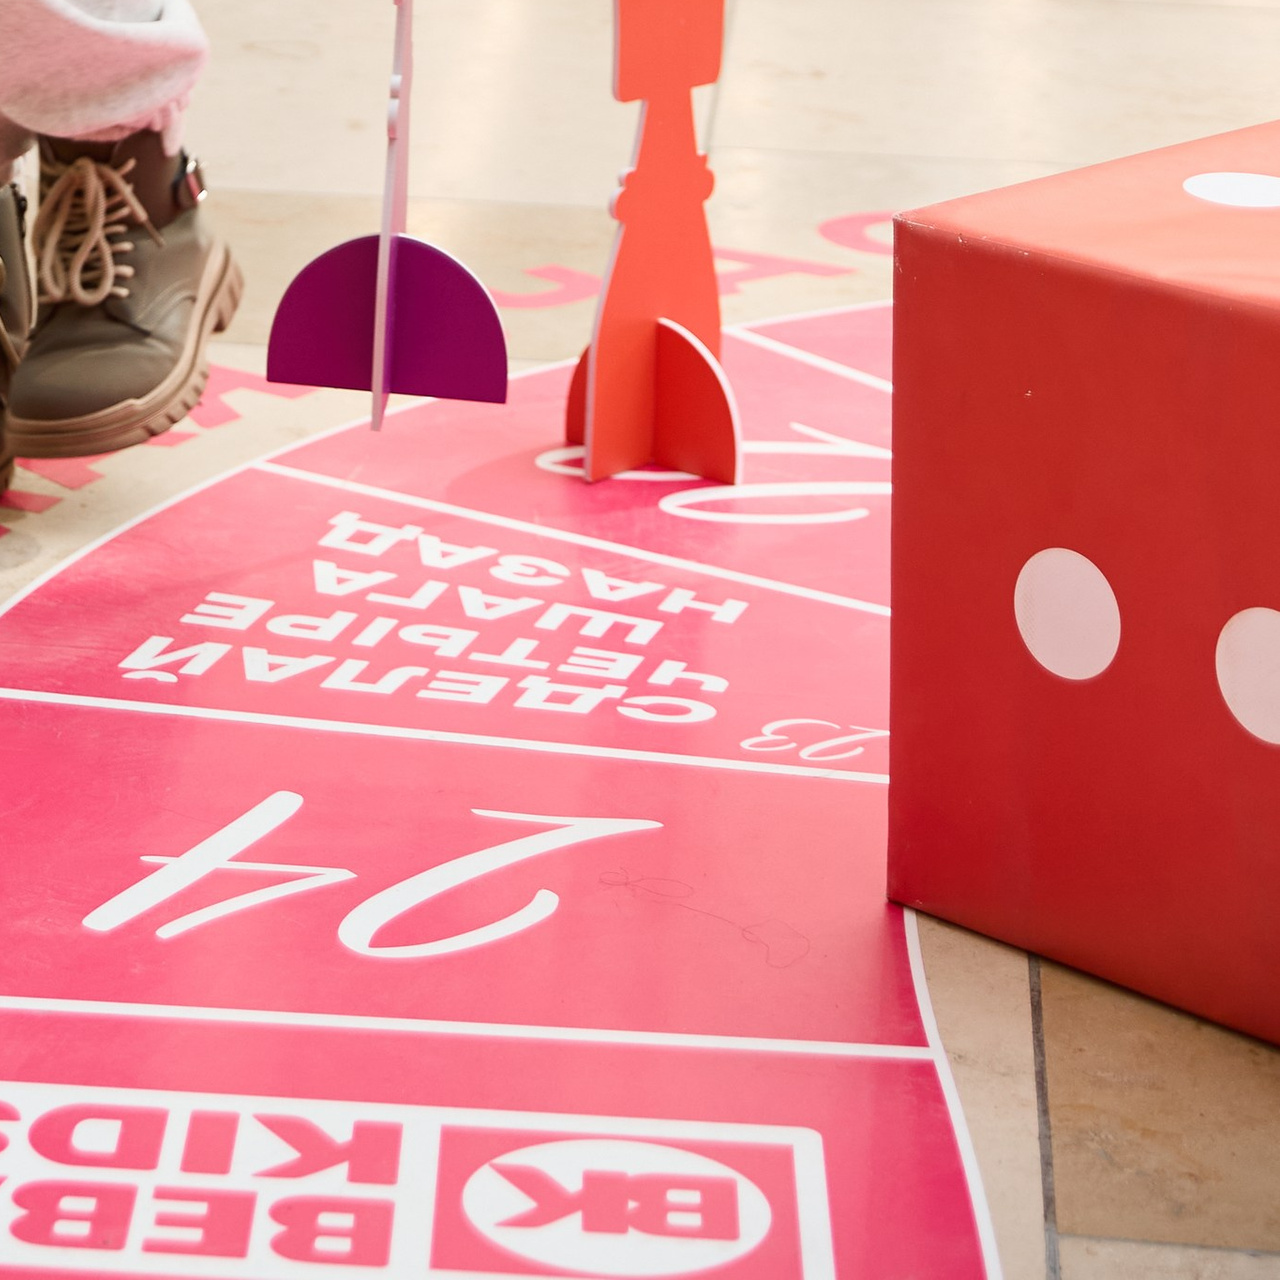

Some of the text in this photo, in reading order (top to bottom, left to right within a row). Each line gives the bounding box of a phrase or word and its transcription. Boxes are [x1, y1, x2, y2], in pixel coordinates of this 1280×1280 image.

[312, 558, 665, 645] ШАГА
[316, 510, 749, 624] НАЗАД
[117, 635, 718, 724] СДЕЛАЙ
[179, 591, 730, 693] ЧЕТЫРЕ
[739, 718, 891, 762] 23
[81, 790, 665, 958] 24
[485, 1162, 742, 1243] BK
